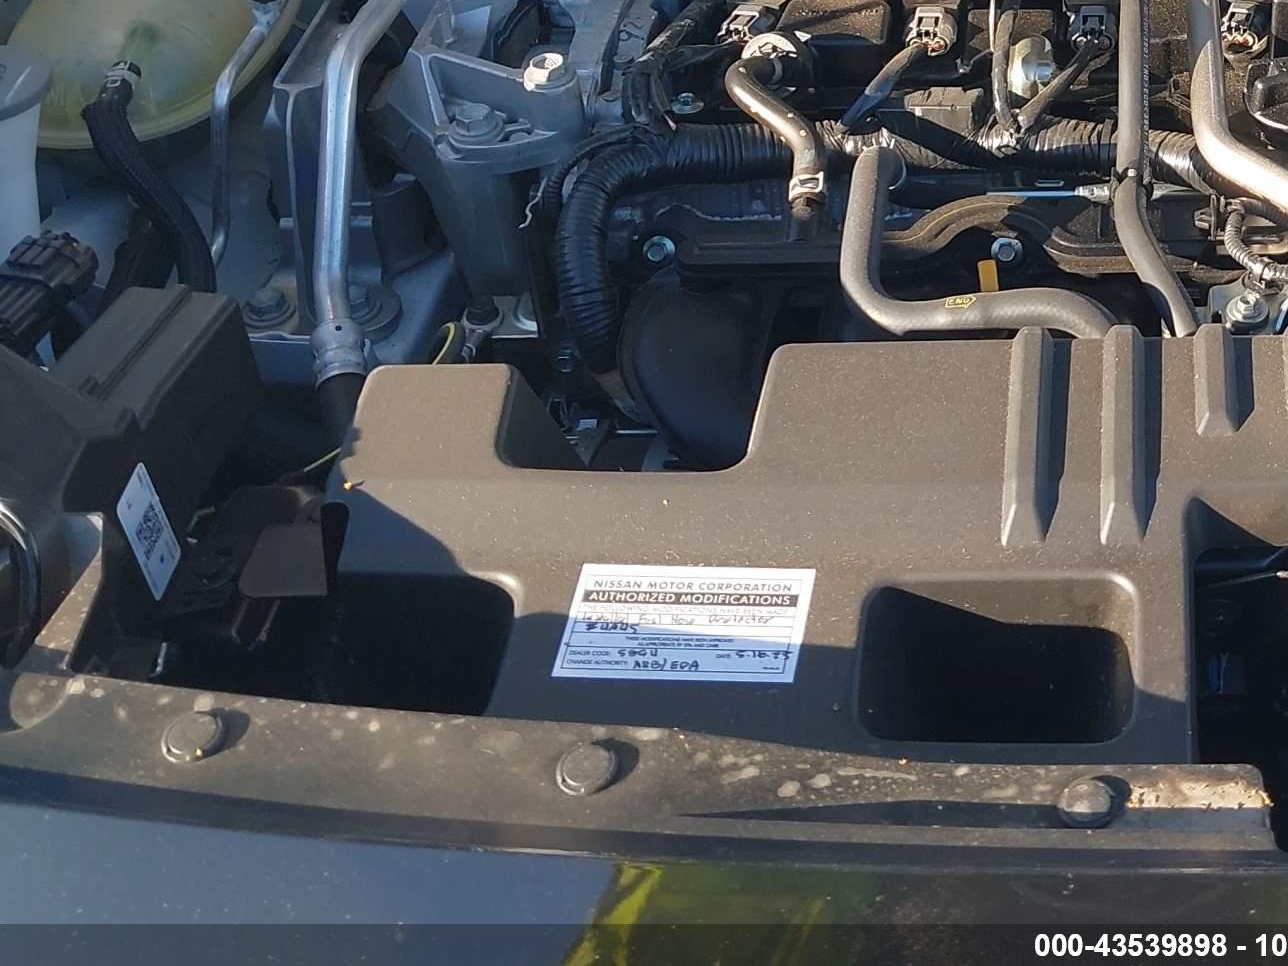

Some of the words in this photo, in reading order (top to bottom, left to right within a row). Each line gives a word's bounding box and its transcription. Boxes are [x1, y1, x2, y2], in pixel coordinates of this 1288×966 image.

[593, 579, 642, 589] NISSAN
[648, 581, 694, 590] MOTOR
[699, 582, 792, 592] CORPORATION
[589, 591, 676, 603] AUTHORIZED
[680, 593, 791, 605] MODIFICATIONS
